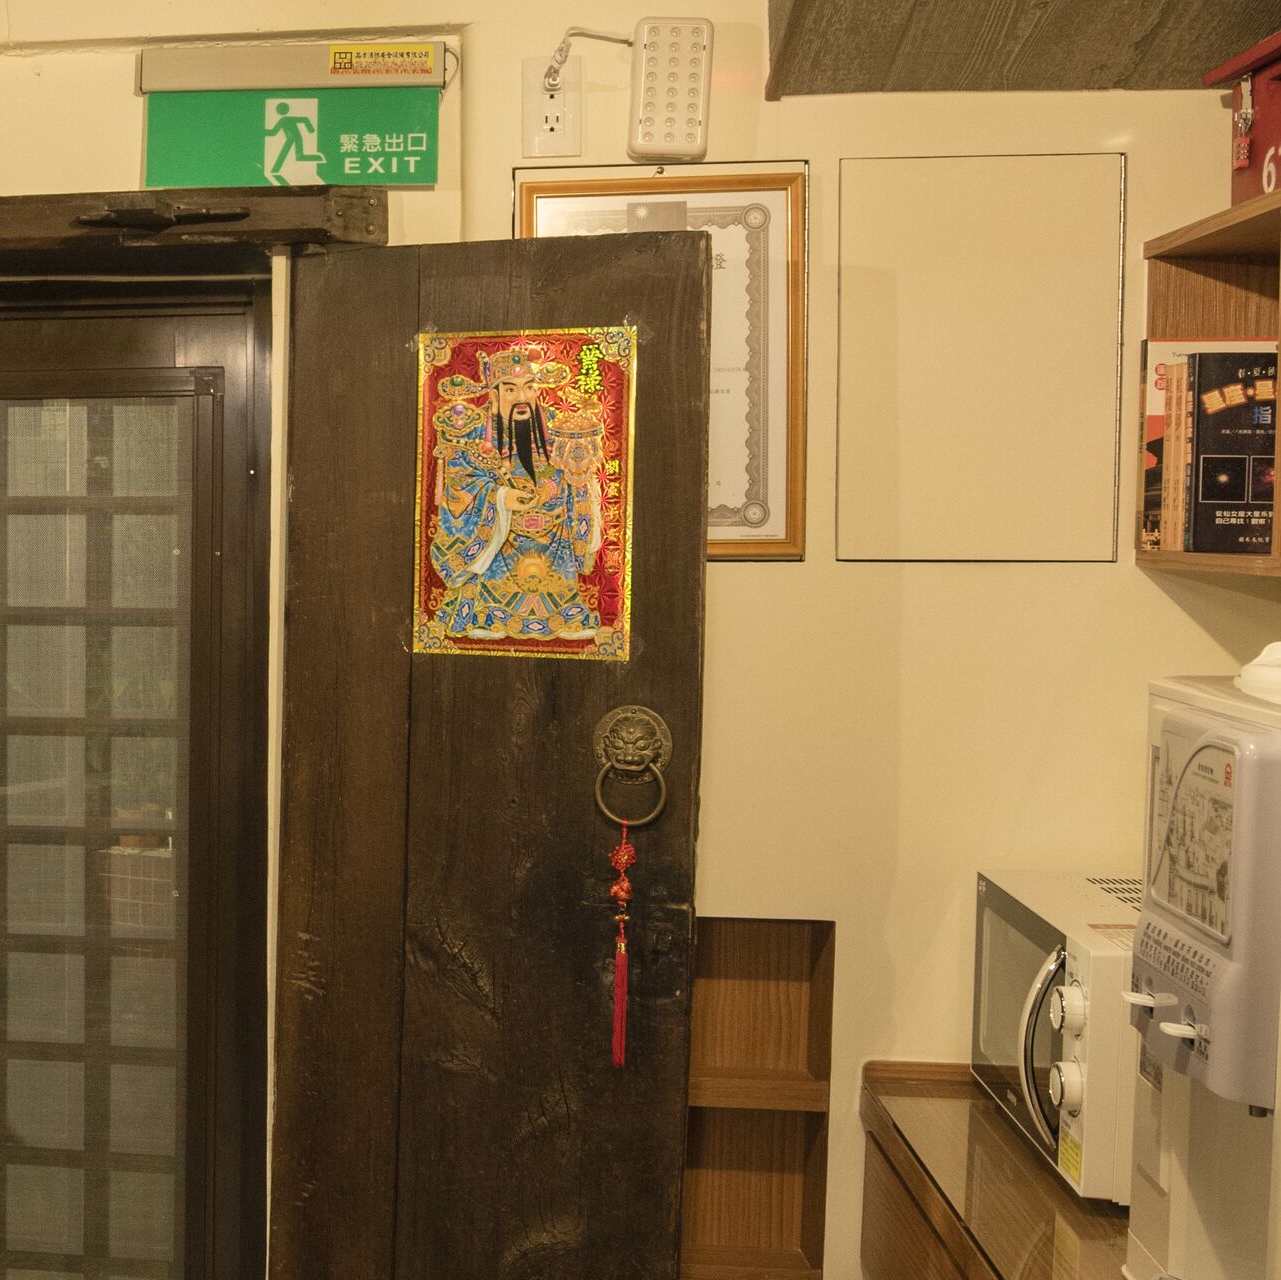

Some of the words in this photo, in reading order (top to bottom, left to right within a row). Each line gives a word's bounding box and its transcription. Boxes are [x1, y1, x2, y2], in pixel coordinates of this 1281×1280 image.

[340, 133, 427, 153] 緊急出口
[344, 156, 421, 174] EXIT
[1262, 145, 1281, 194] 6
[1201, 380, 1277, 415] 星座·星
[1253, 406, 1272, 425] 指
